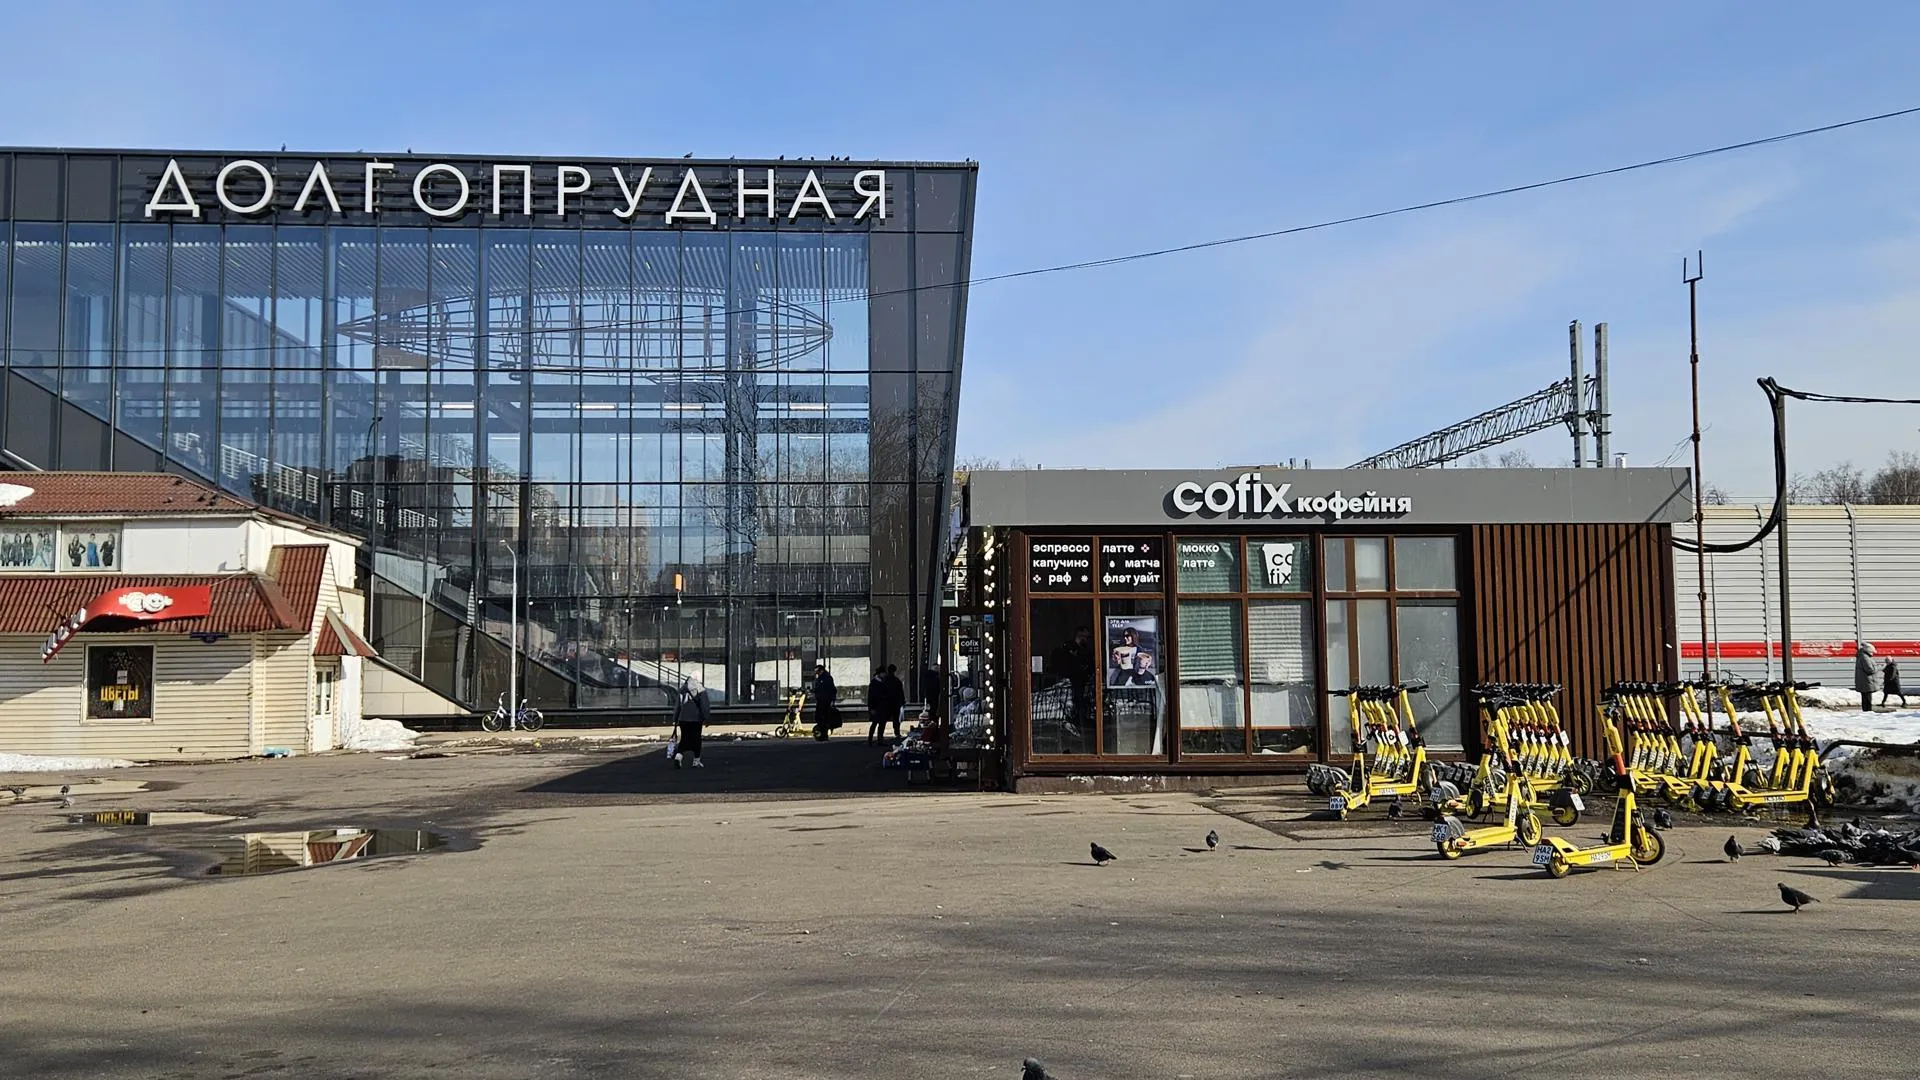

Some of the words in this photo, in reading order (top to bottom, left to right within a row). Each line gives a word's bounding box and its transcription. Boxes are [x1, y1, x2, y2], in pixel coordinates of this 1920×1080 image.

[144, 158, 888, 226] ДОЛГОПРУДНАЯ
[1172, 472, 1293, 513] cofix
[1297, 490, 1412, 519] кофейня
[1032, 543, 1090, 556] эспрессо
[1102, 544, 1135, 553] латте
[1182, 543, 1220, 553] мокко
[1032, 559, 1089, 571] капучино
[1124, 559, 1160, 568] матча
[1182, 559, 1216, 568] латте
[1048, 571, 1072, 586] раф
[1102, 571, 1131, 586] флэт
[1133, 571, 1160, 586] уайт
[1269, 568, 1292, 585] fix
[1536, 845, 1552, 855] HA2
